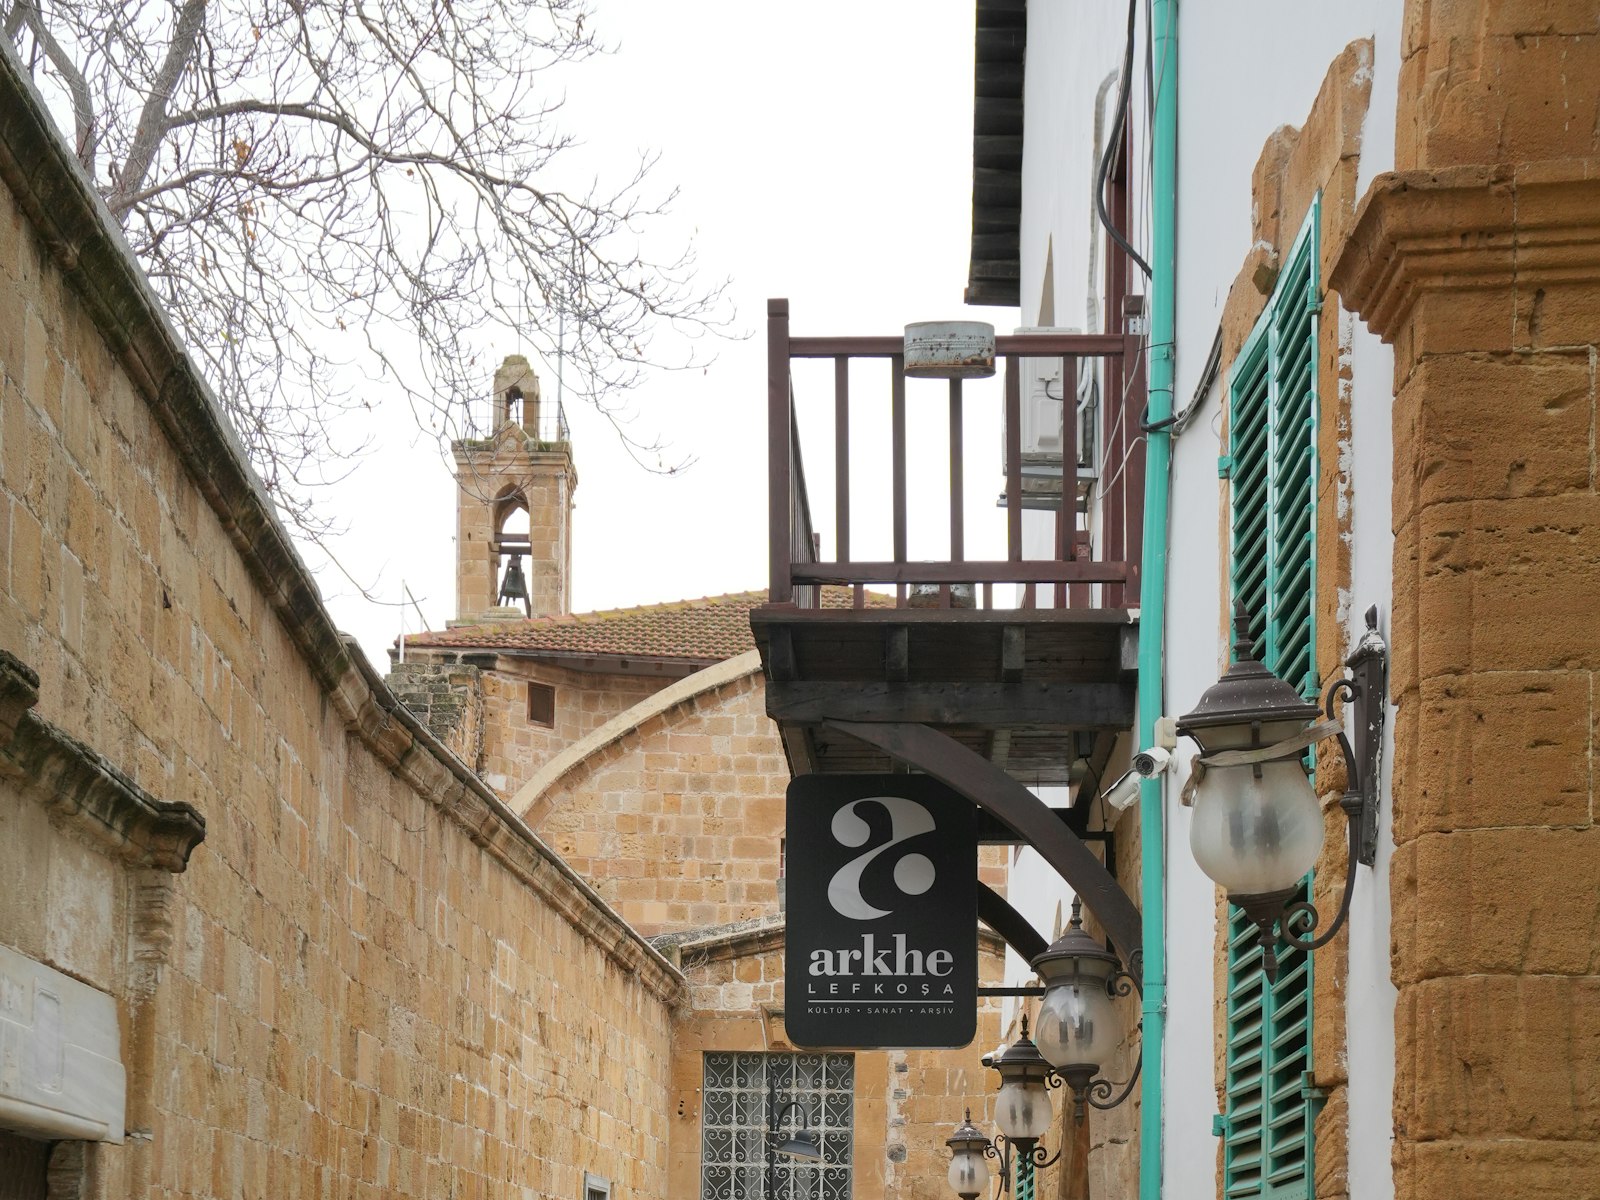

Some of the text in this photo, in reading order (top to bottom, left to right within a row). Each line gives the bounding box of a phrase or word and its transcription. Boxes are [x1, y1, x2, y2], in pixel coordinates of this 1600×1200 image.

[808, 933, 954, 977] arkhe
[808, 983, 954, 996] LEFKOŞA
[807, 1006, 851, 1014] KÜLTÜR
[920, 1006, 954, 1015] ARŞİV
